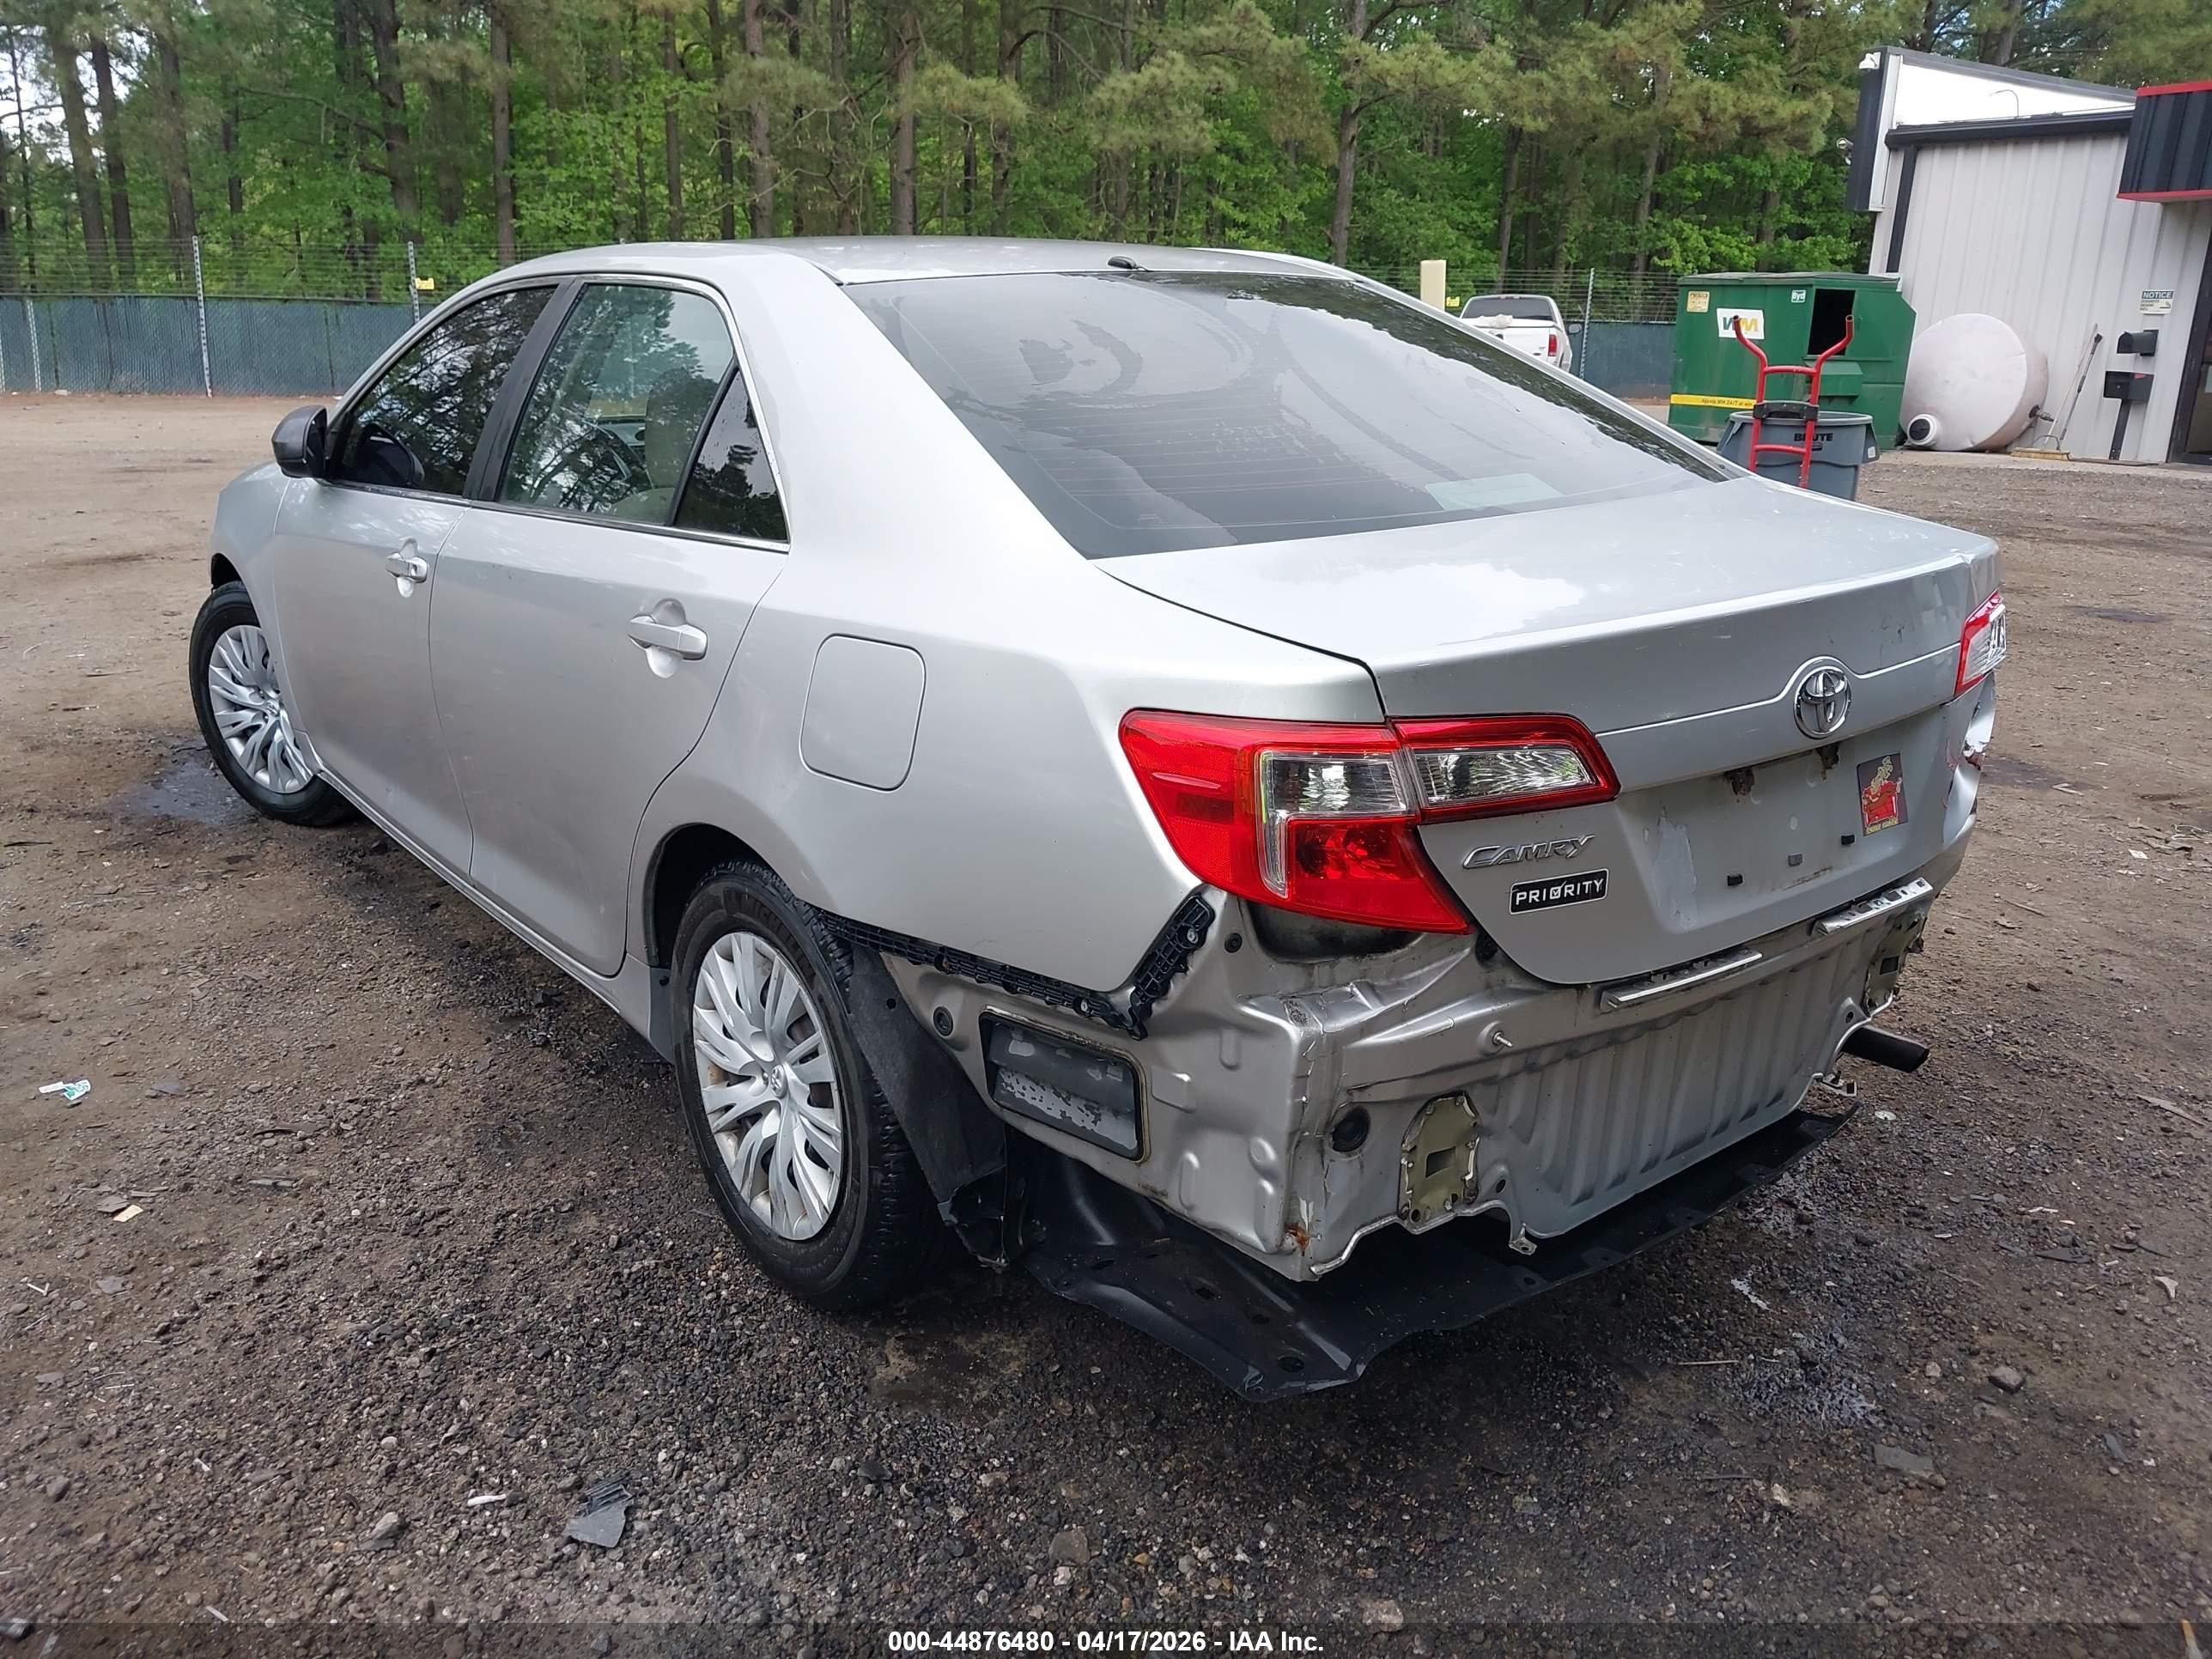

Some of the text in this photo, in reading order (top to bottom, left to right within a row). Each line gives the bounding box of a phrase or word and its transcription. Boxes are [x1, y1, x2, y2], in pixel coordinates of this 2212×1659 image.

[1794, 433, 1833, 441] BUTE
[1462, 835, 1595, 869] CAMRY
[1516, 878, 1604, 905] PRIORITY
